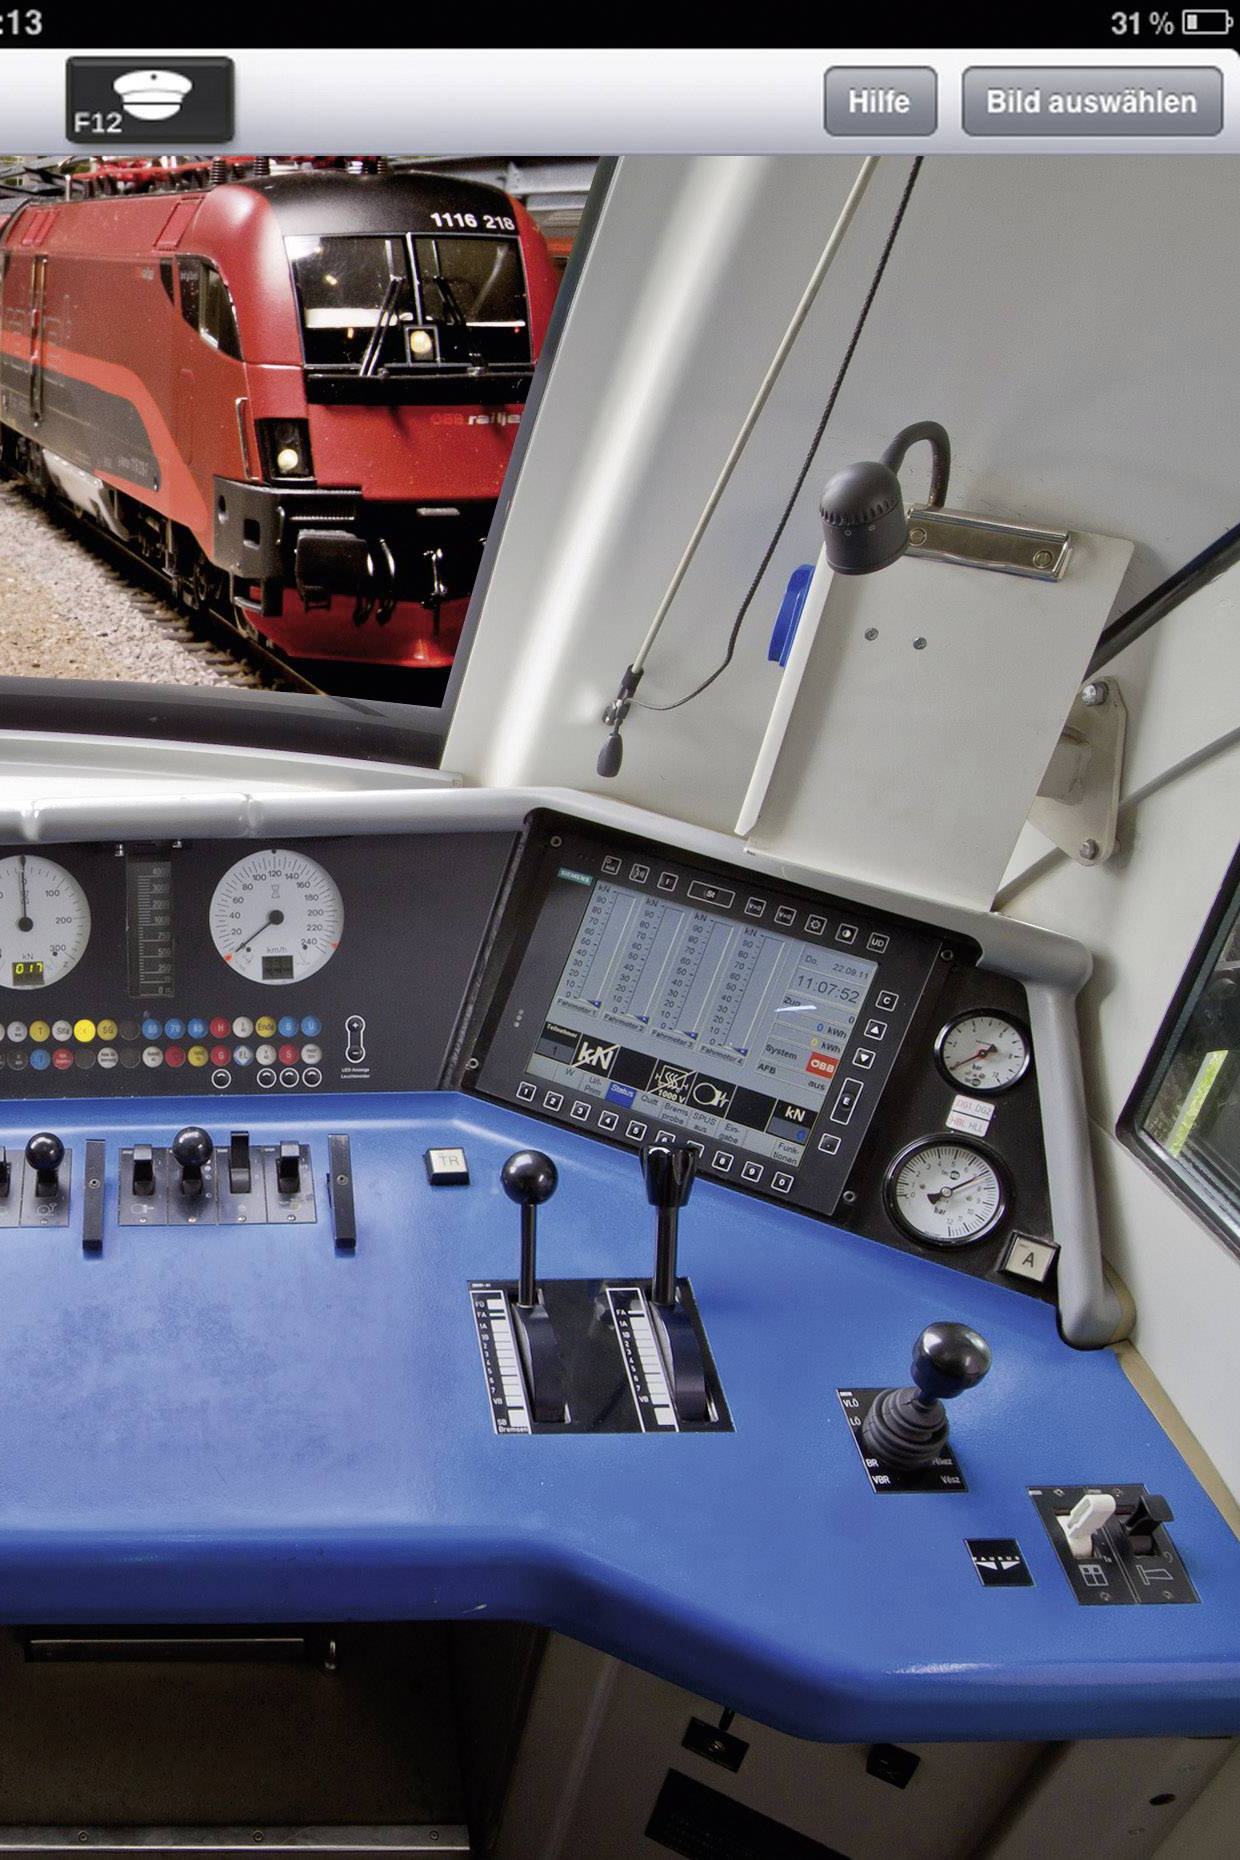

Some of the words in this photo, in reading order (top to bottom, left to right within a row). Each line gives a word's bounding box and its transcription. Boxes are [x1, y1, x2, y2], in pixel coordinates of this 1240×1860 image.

[430, 212, 478, 227] 1116
[483, 215, 515, 230] 218
[871, 938, 884, 947] UD
[796, 975, 860, 1004] 11:07:52
[883, 996, 891, 1004] C
[604, 1013, 638, 1031] Fahrmotor
[651, 1029, 686, 1048] Fahrmotor
[827, 1026, 847, 1039] kWh
[765, 1044, 798, 1061] System
[821, 1041, 841, 1054] kWh
[578, 1041, 614, 1070] kN
[757, 1062, 777, 1075] AFB
[610, 1083, 634, 1099] Status
[807, 1080, 826, 1092] aus
[692, 1111, 717, 1126] SPUS
[785, 1105, 806, 1122] kN
[439, 1155, 460, 1167] TR
[934, 1206, 947, 1216] bar
[1022, 1252, 1034, 1268] A
[865, 1458, 879, 1468] BR
[871, 1475, 891, 1484] VBR
